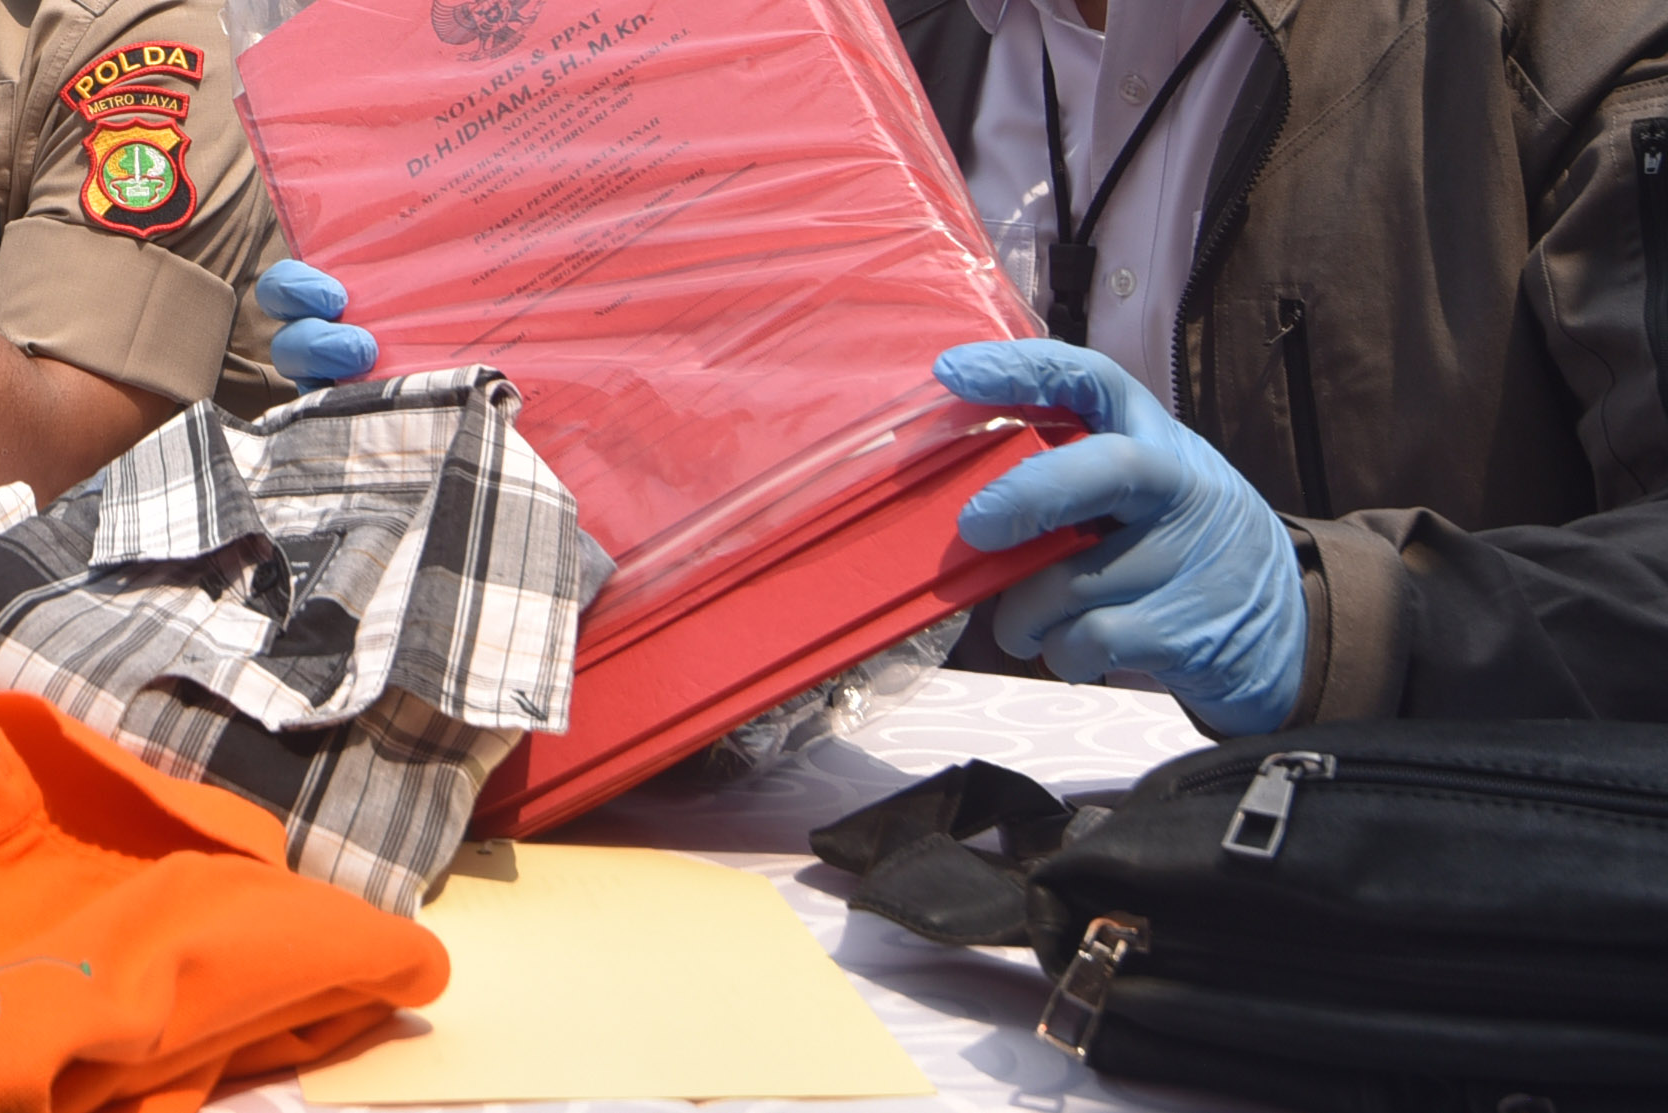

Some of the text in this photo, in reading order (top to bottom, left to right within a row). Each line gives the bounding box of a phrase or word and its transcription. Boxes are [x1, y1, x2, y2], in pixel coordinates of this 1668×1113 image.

[75, 47, 188, 100] POLDA
[433, 9, 603, 129] NOTARIS & PPAT
[87, 94, 178, 116] METRO JAYA
